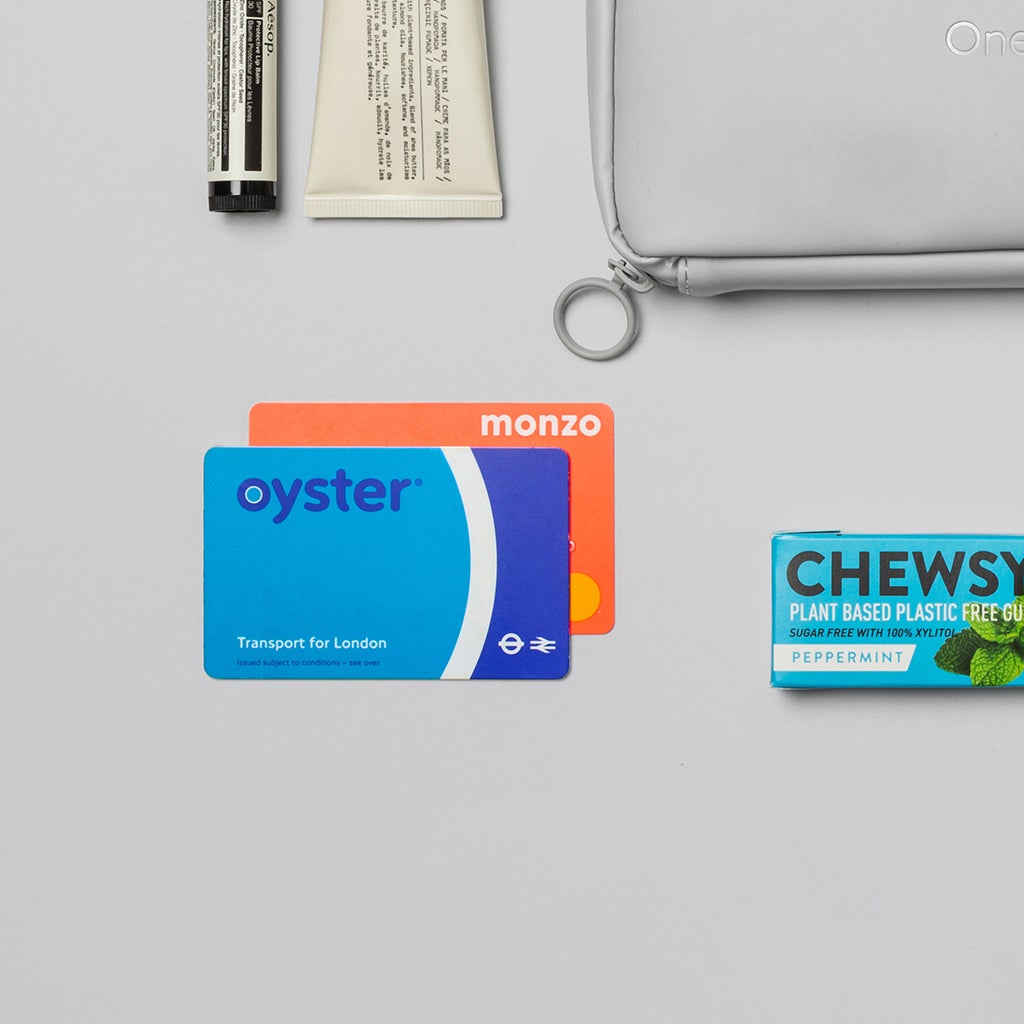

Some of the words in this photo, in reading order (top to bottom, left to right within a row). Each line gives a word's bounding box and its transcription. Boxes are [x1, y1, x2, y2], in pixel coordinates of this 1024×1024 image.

[248, 1, 254, 9] 30
[264, 1, 275, 56] Aesop.
[374, 23, 379, 31] de
[382, 29, 387, 37] de
[367, 50, 372, 58] et
[386, 140, 391, 148] de
[387, 172, 392, 180] de
[480, 414, 601, 437] monzo
[790, 602, 838, 622] PLANT
[842, 602, 891, 622] BASED
[896, 602, 957, 622] PLASTIC
[962, 603, 998, 622] FREE
[789, 628, 824, 638] SUGAR
[827, 628, 854, 637] FREE
[857, 628, 883, 637] WITH
[887, 628, 912, 637] 100%
[915, 628, 957, 637] XYLITOL
[237, 637, 305, 651] Transport
[310, 637, 330, 649] for
[334, 637, 386, 649] London
[792, 651, 903, 663] PEPPERMINT
[263, 659, 289, 668] subject
